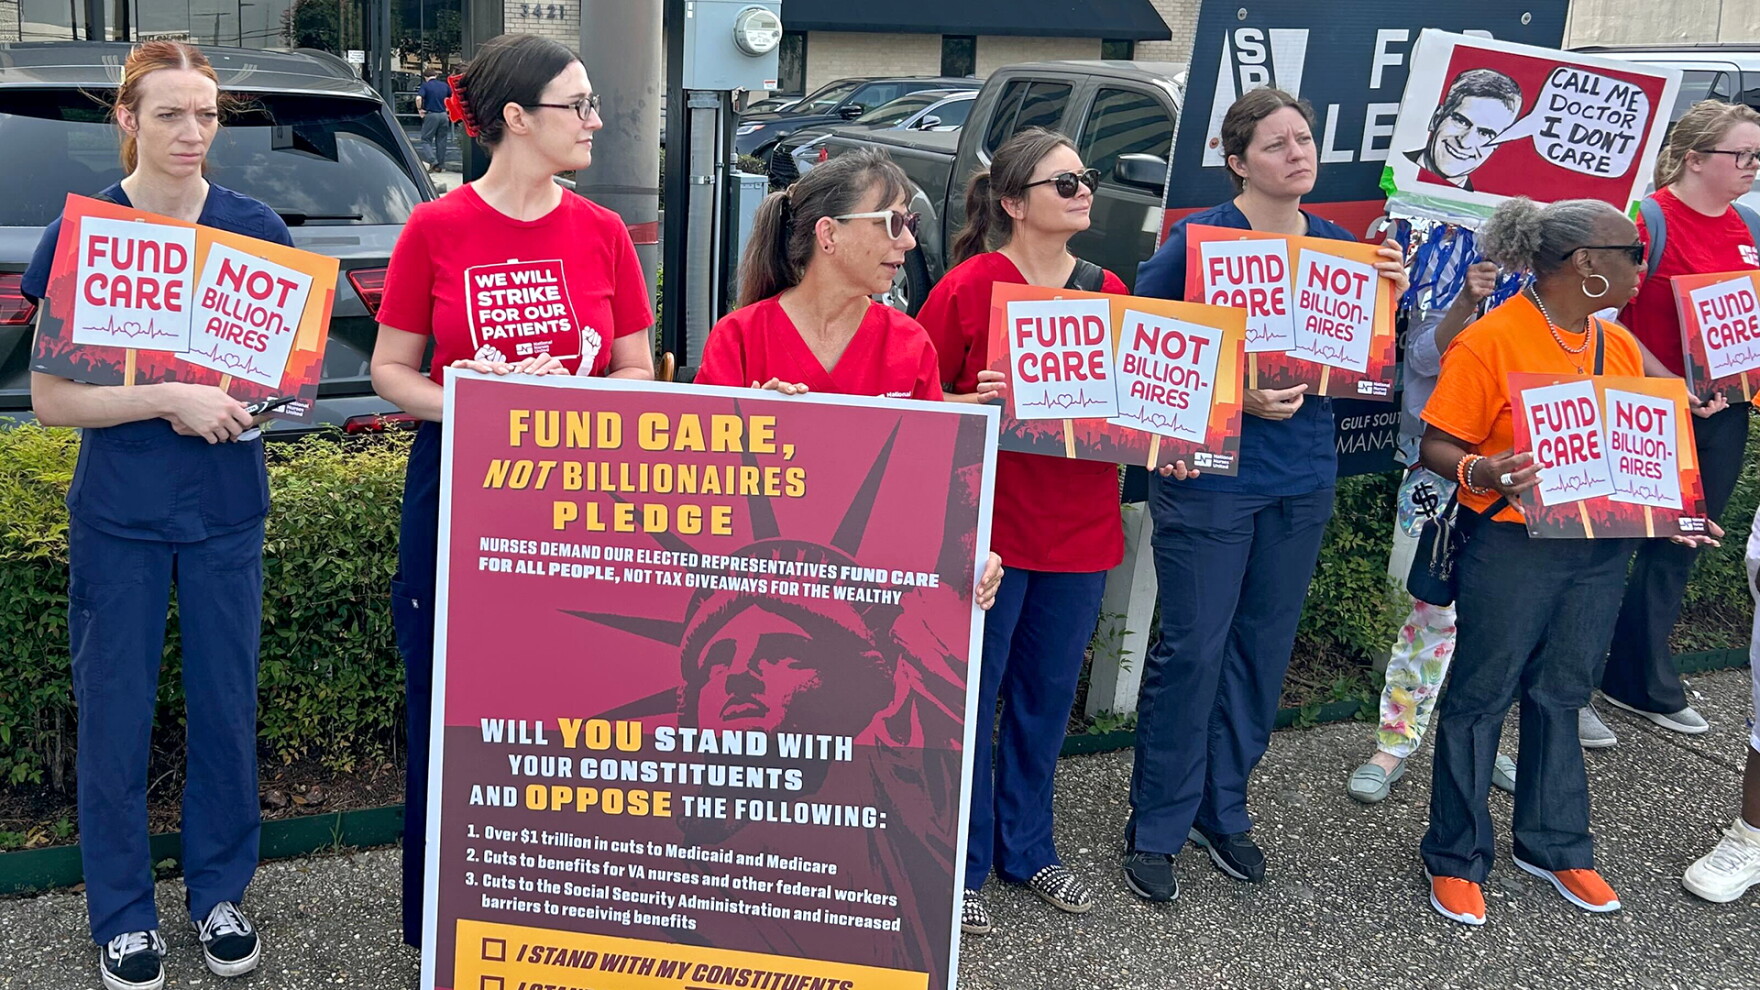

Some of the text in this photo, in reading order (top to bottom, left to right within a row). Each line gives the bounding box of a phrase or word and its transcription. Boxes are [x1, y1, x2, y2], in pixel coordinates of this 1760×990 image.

[521, 4, 564, 19] 3421
[1551, 69, 1643, 112] CALL ME
[1540, 116, 1562, 139] I
[1549, 94, 1636, 129] DOCTOR
[1547, 143, 1611, 173] CARE
[88, 235, 188, 275] FUND
[1208, 254, 1285, 286] FUND
[83, 273, 183, 312] CARE
[216, 258, 298, 308] NOT
[475, 269, 557, 288] WE WILL
[477, 285, 561, 306] STRIKE
[1307, 261, 1369, 300] NOT
[201, 287, 290, 334] BILLION-
[479, 303, 567, 323] FOR OUR
[1211, 287, 1286, 317] CARE
[1299, 289, 1369, 324] BILLION-
[1699, 289, 1754, 325] FUND
[205, 316, 270, 352] AIRES
[481, 318, 571, 340] PATIENTS
[1016, 315, 1105, 348] FUND
[1133, 322, 1210, 365] NOT
[1305, 314, 1354, 342] AIRES
[1707, 315, 1760, 350] CARE
[1018, 350, 1107, 383] CARE
[1122, 353, 1208, 391] BILLION-
[1130, 380, 1190, 410] AIRES
[1340, 415, 1371, 430] GULF
[1530, 396, 1596, 435] FUND
[1615, 400, 1668, 436] NOT
[509, 409, 796, 460] FUND CARE,
[1336, 430, 1400, 454] MANA
[1537, 429, 1601, 469] CARE
[1611, 430, 1673, 461] BILLION-
[482, 459, 807, 497] NOT BILLIONAIRES
[1619, 456, 1663, 480] AIRES
[553, 500, 733, 536] PLEDGE
[480, 537, 940, 588] NURSES DEMAND OUR ELECTED REPRESENTATIVES FUND CARE
[479, 557, 902, 605] FOR ALL PEOPLE, NOT TAX GIVEAWAYS FOR THE WEALTHY
[480, 717, 853, 762] WILL YOU STAND WITH
[508, 753, 803, 791] YOUR CONSTITUENTS
[469, 784, 887, 829] AND OPPOSE THE FOLLOWING:
[467, 824, 837, 875] 1. Over $1 trillion in cuts to Medicaid and Medicare
[466, 848, 898, 907] 2. Cuts to benefits for VA nurses and other federal workers
[465, 872, 901, 932] 3. Cuts to the Social Security Administration and increased
[481, 893, 697, 930] barriers to receiving benefits
[516, 944, 854, 990] I STAND WITH MY CONSTITUENTS
